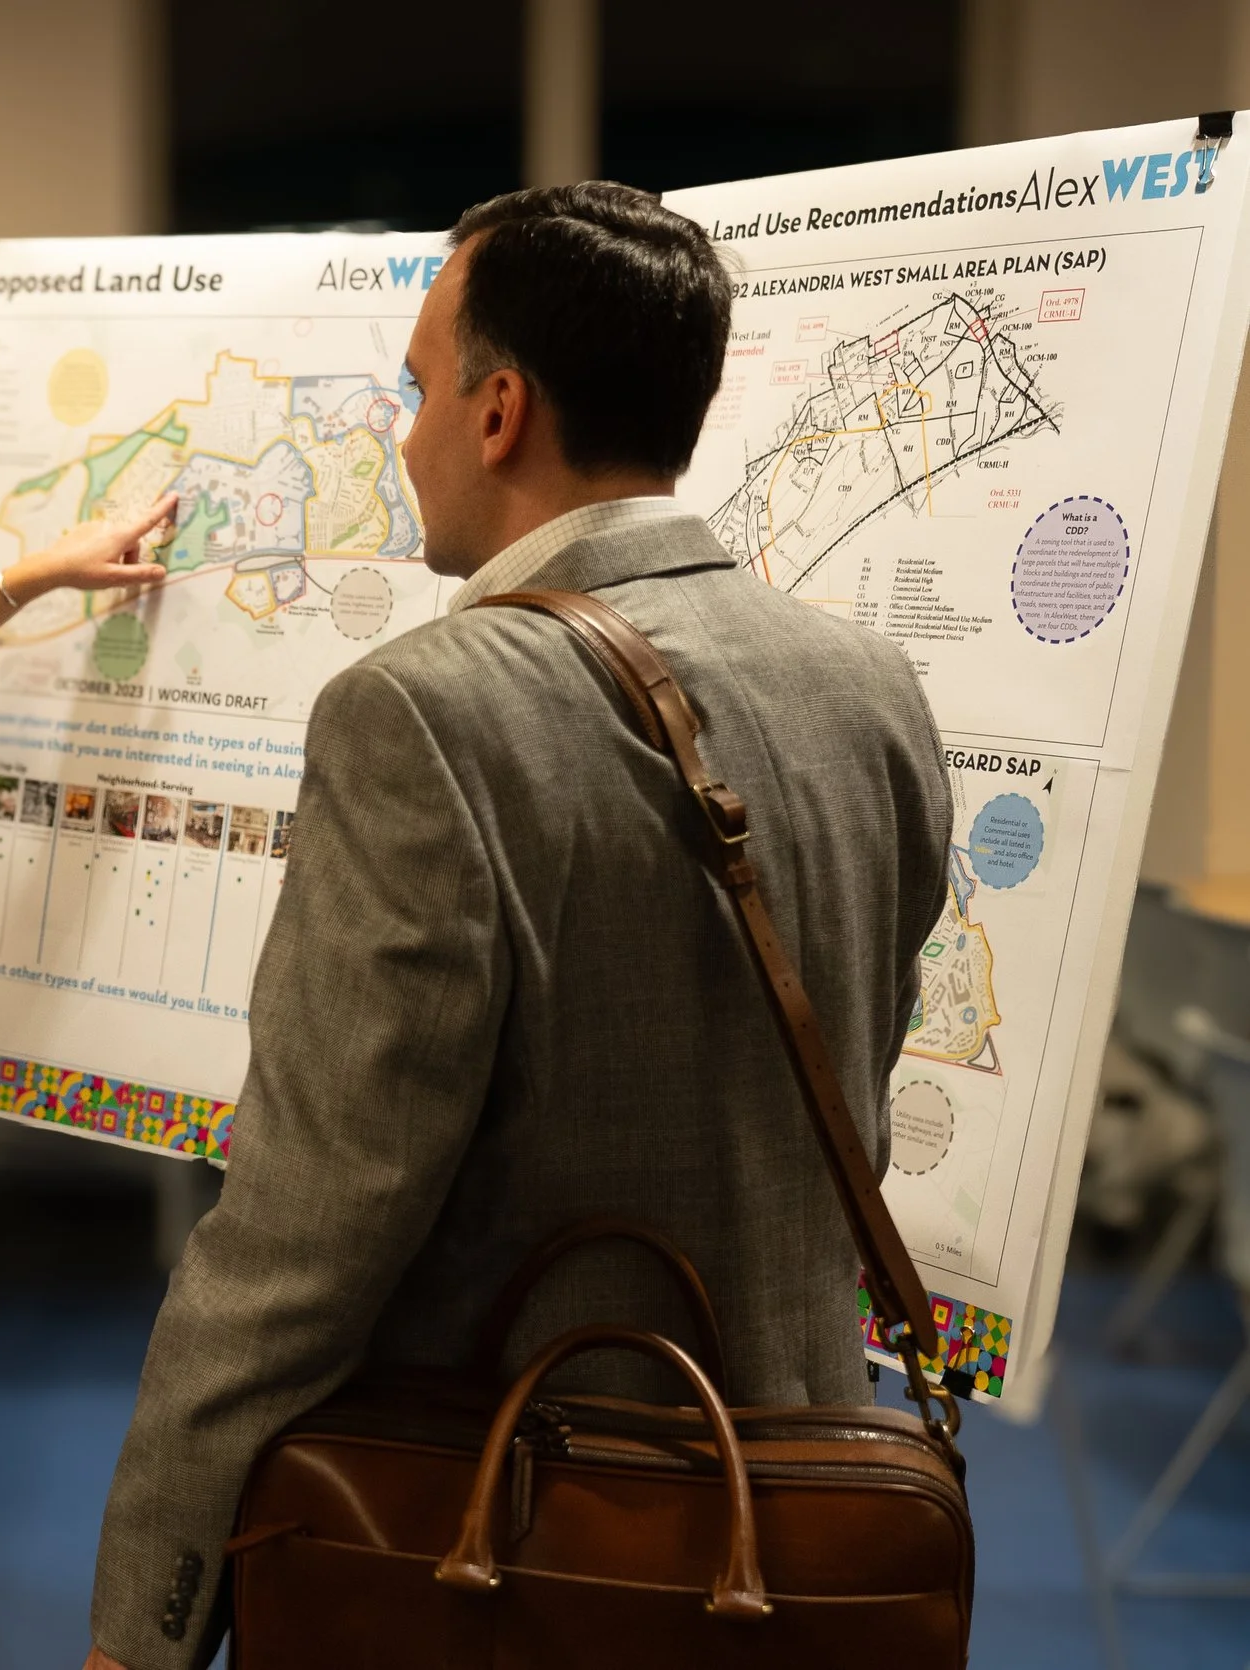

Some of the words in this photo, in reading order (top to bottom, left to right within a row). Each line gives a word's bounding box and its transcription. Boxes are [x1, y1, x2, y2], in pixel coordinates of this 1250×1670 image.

[713, 214, 761, 241] Land
[765, 212, 801, 235] Use
[806, 186, 1017, 231] Recommendations
[316, 256, 443, 291] AlexWE
[751, 274, 844, 298] ALEXANDRIA
[850, 268, 893, 288] WEST
[896, 263, 948, 284] SMALL
[953, 258, 998, 279] AREA
[1003, 253, 1050, 275] PLAN
[1054, 247, 1107, 276] (SAP)
[94, 264, 162, 292] Land
[172, 264, 223, 293] Use
[932, 292, 943, 301] CG
[965, 287, 994, 298] OCM-100
[995, 293, 1005, 302] CG
[1046, 299, 1060, 307] Ord.
[949, 322, 961, 330] RM
[1002, 322, 1032, 332] OCM-100
[731, 331, 749, 341] West
[751, 329, 771, 340] Land
[730, 346, 764, 357] amended
[1026, 353, 1058, 362] OCM-100
[1062, 513, 1083, 522] What
[1084, 513, 1091, 522] is
[1065, 527, 1089, 535] CDD?
[1041, 539, 1059, 547] zoning
[1069, 549, 1111, 558] redevelopment
[115, 681, 144, 698] 2023
[158, 688, 221, 707] WORKING
[225, 694, 267, 711] DRAFT
[86, 719, 107, 734] dot
[111, 724, 160, 742] stickers
[163, 731, 179, 742] on
[182, 729, 205, 745] the
[208, 735, 244, 751] types
[248, 737, 263, 750] of
[266, 738, 305, 756] busin
[103, 749, 123, 759] are
[125, 747, 192, 766] interested
[195, 756, 208, 768] in
[212, 759, 254, 777] seeing
[258, 762, 270, 776] in
[273, 764, 305, 780] Alex
[1006, 756, 1041, 777] SAP
[990, 816, 1020, 827] Residential
[984, 826, 1017, 837] Commercial
[1018, 852, 1033, 860] office
[10, 965, 42, 981] other
[45, 971, 78, 990] types
[81, 977, 96, 991] of
[98, 983, 125, 997] uses
[128, 988, 168, 1006] would
[171, 996, 194, 1010] you
[198, 998, 220, 1015] like
[224, 1004, 238, 1018] to
